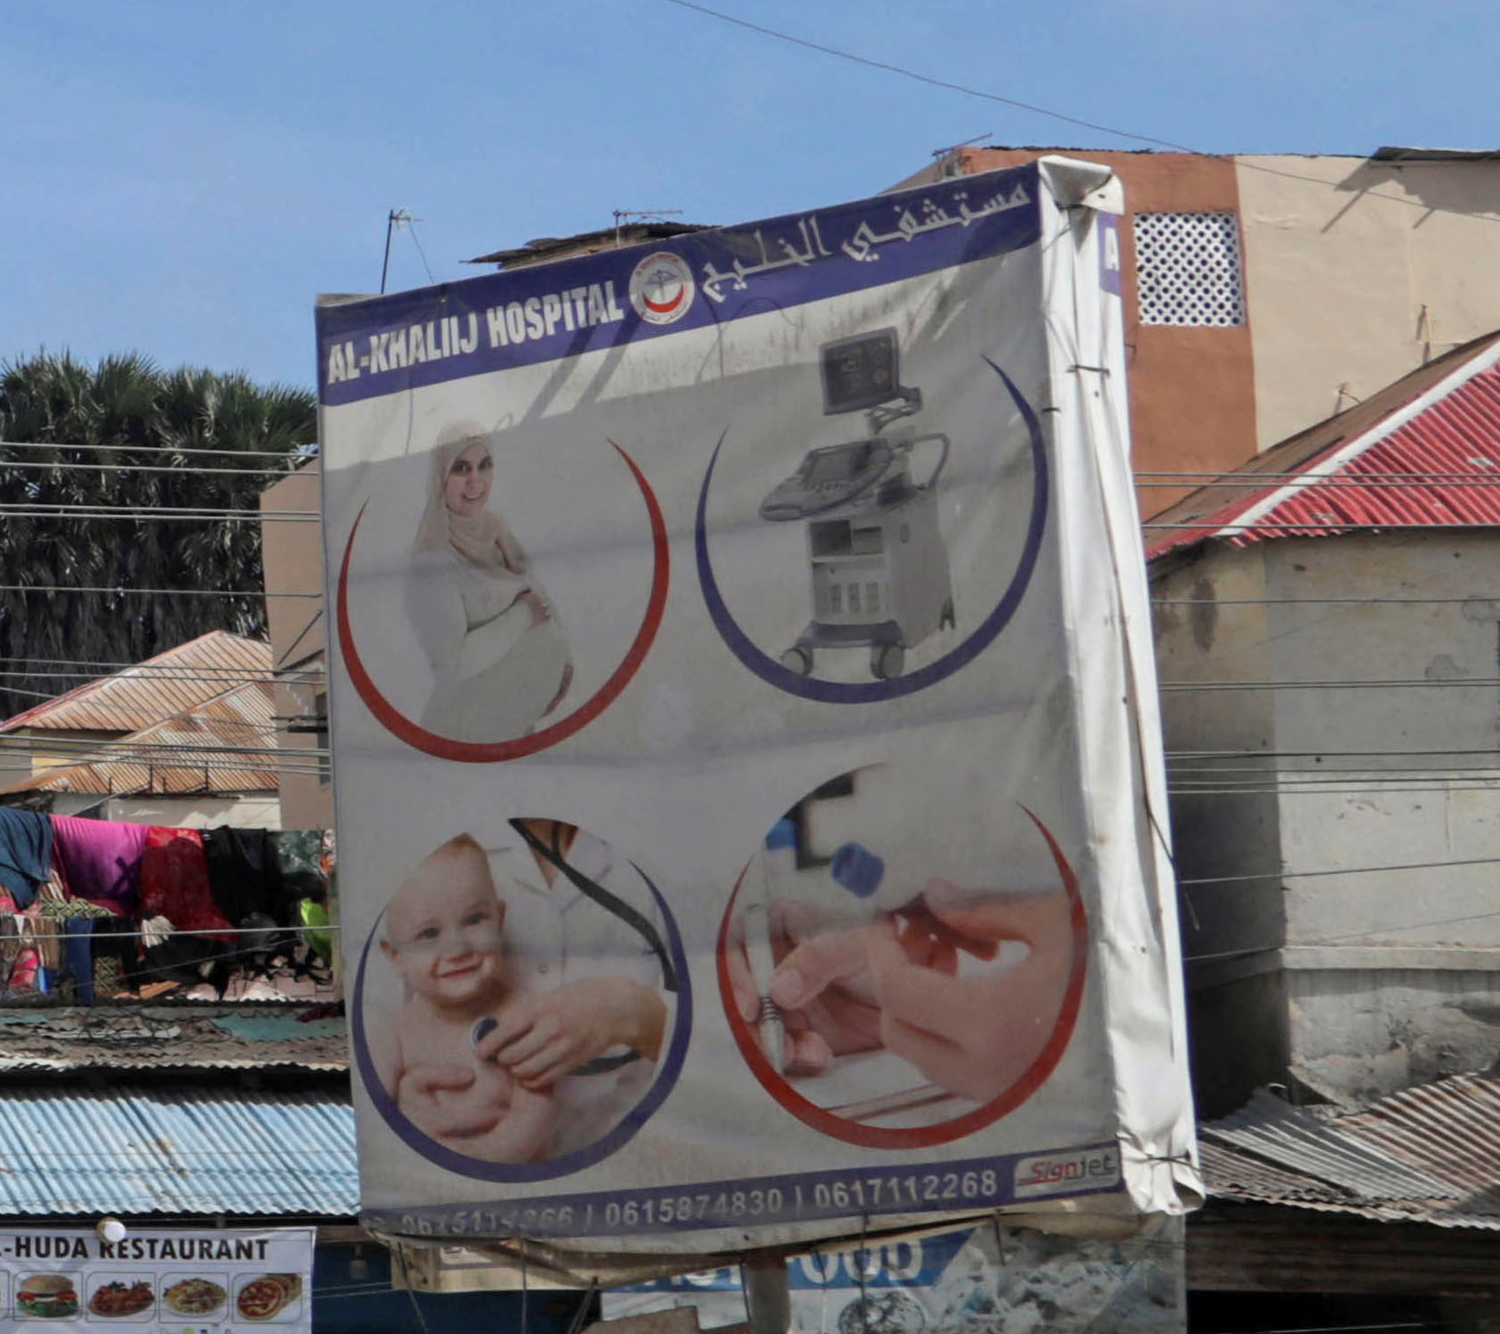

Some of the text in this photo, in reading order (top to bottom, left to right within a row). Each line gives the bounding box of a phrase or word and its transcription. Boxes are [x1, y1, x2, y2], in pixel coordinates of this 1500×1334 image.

[327, 278, 624, 384] AL-KHALIIJ HOSPITAL
[605, 1187, 783, 1226] 0615874830
[814, 1169, 998, 1209] 0617112268
[100, 1236, 270, 1261] RESTAURANT
